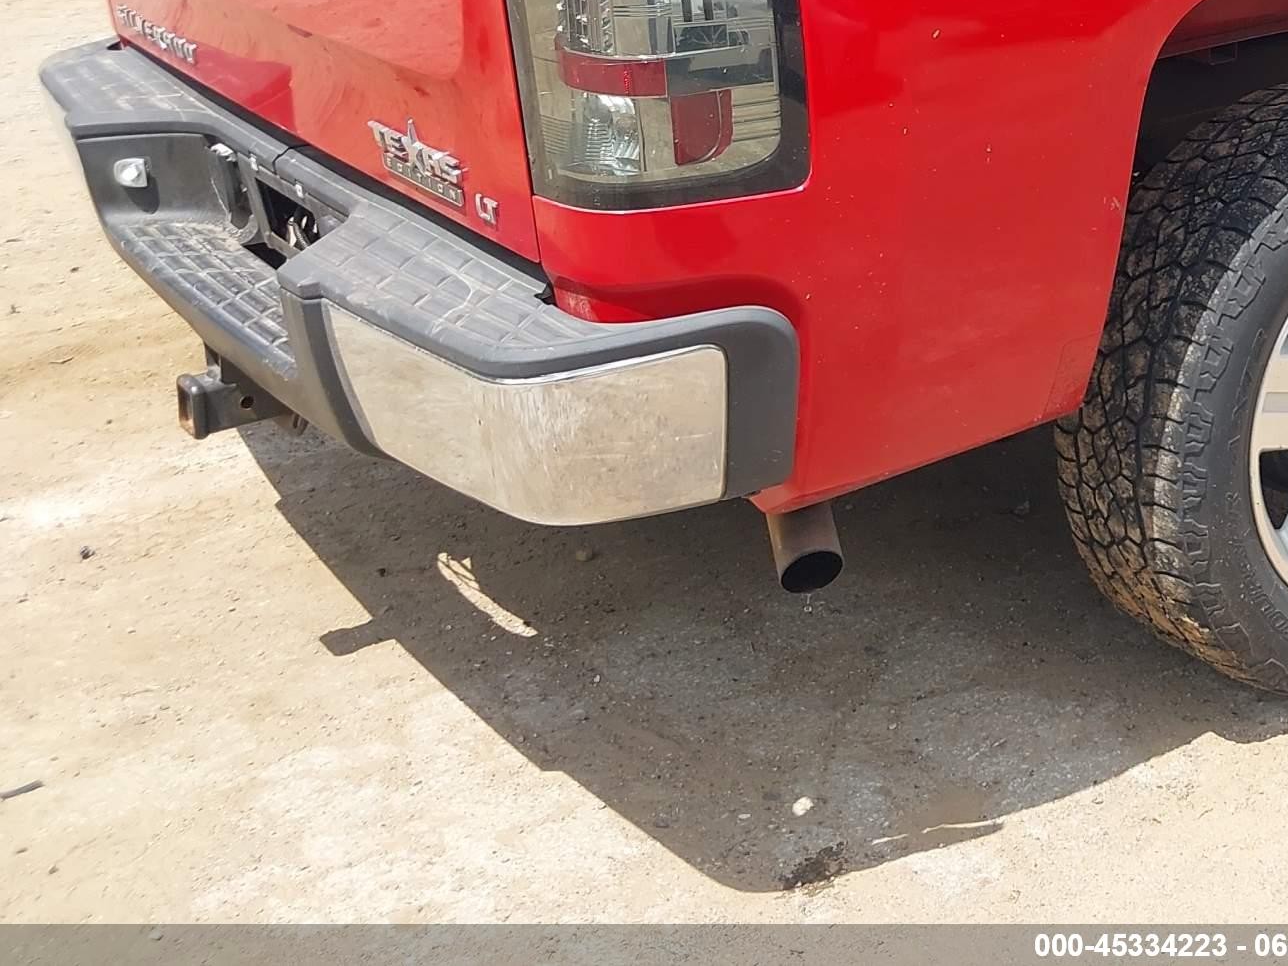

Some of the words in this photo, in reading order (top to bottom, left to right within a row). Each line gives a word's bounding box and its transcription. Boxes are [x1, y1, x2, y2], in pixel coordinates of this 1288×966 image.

[367, 119, 469, 184] TEXAS
[385, 153, 463, 201] EDITION
[475, 193, 499, 225] LT
